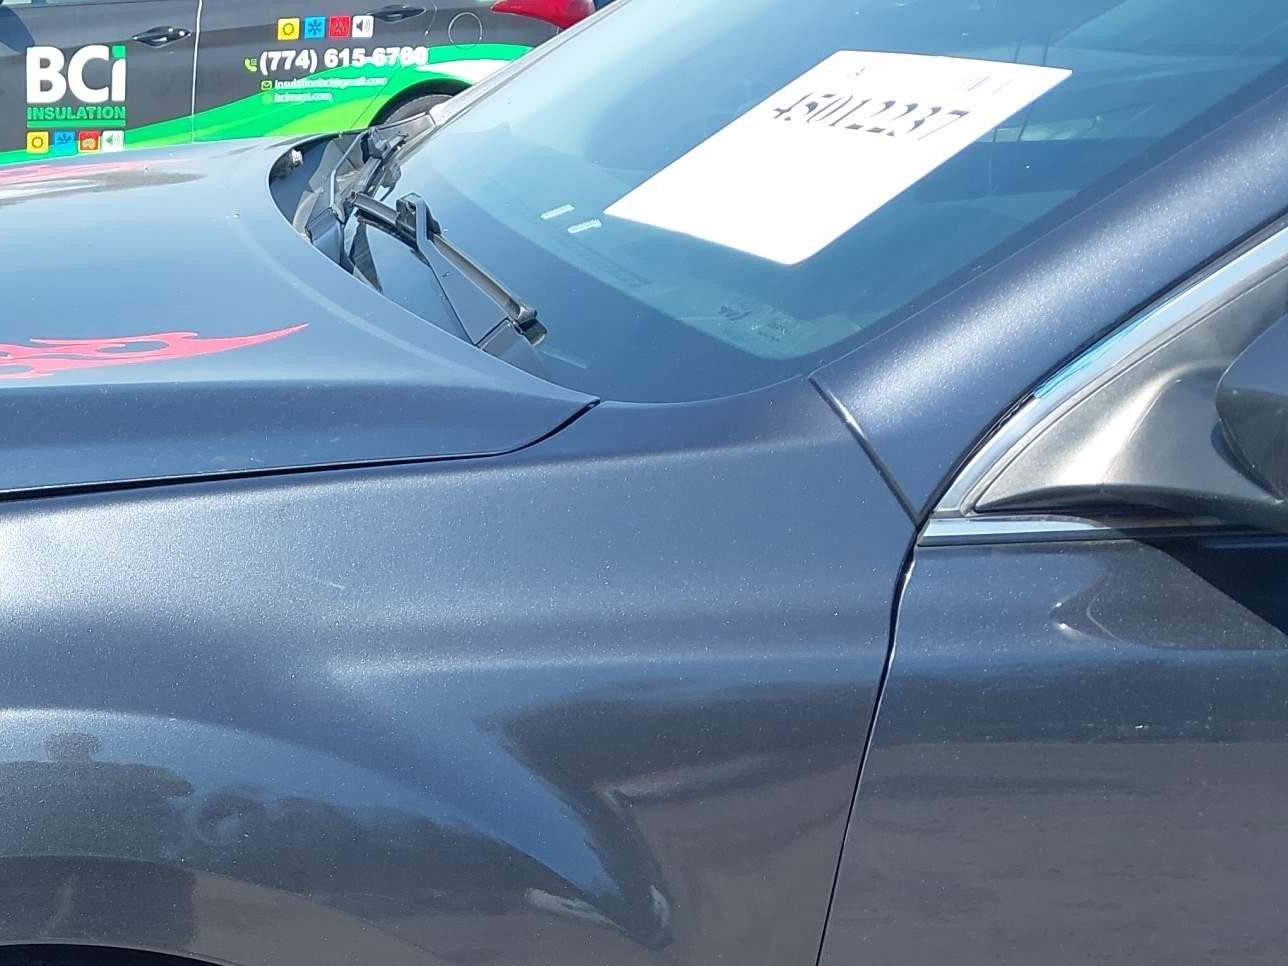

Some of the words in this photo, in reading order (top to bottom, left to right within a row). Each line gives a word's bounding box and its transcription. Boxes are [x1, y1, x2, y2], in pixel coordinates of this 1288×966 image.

[26, 44, 126, 103] BCi
[260, 49, 318, 75] (774)
[26, 106, 126, 120] INSULATION
